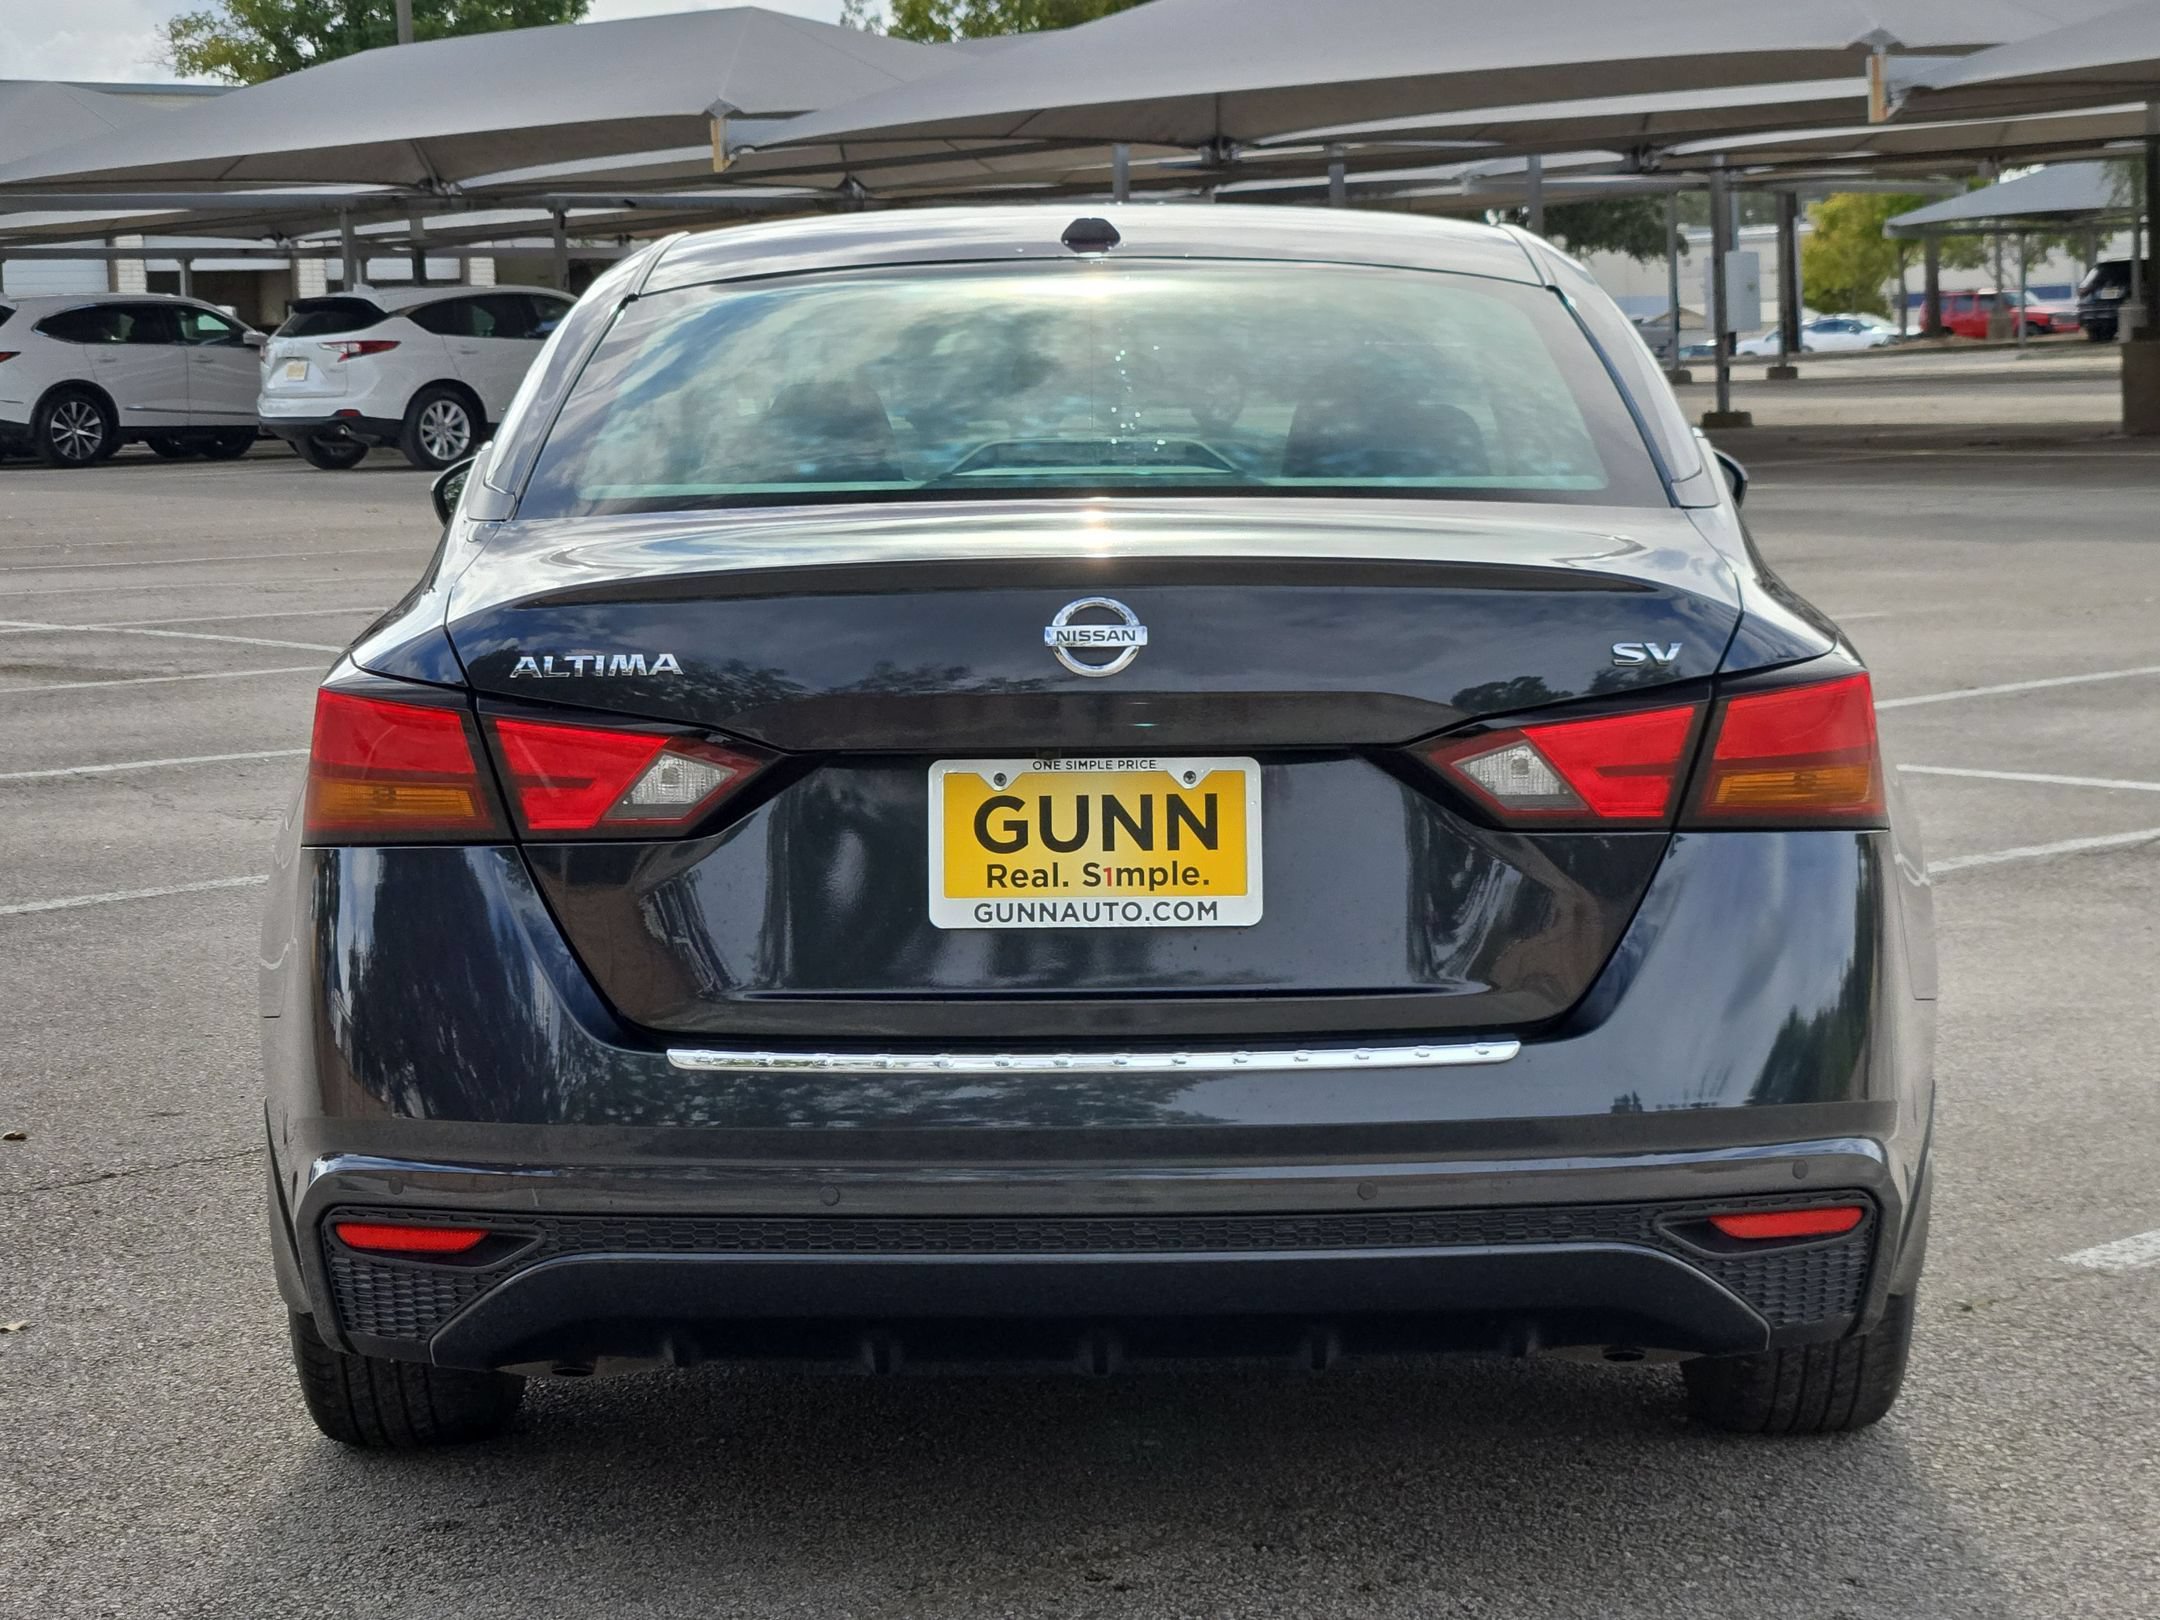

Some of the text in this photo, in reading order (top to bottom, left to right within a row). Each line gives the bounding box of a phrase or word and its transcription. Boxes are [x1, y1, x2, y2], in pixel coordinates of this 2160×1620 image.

[1056, 630, 1136, 642] NISSAN
[509, 653, 684, 679] ALTIMA
[1612, 642, 1683, 666] SV
[1032, 759, 1157, 770] ONE SIMPLE PRICE
[974, 793, 1219, 854] GUNN
[986, 862, 1069, 889] Real.
[974, 900, 1219, 924] GUNNAUTO.COM
